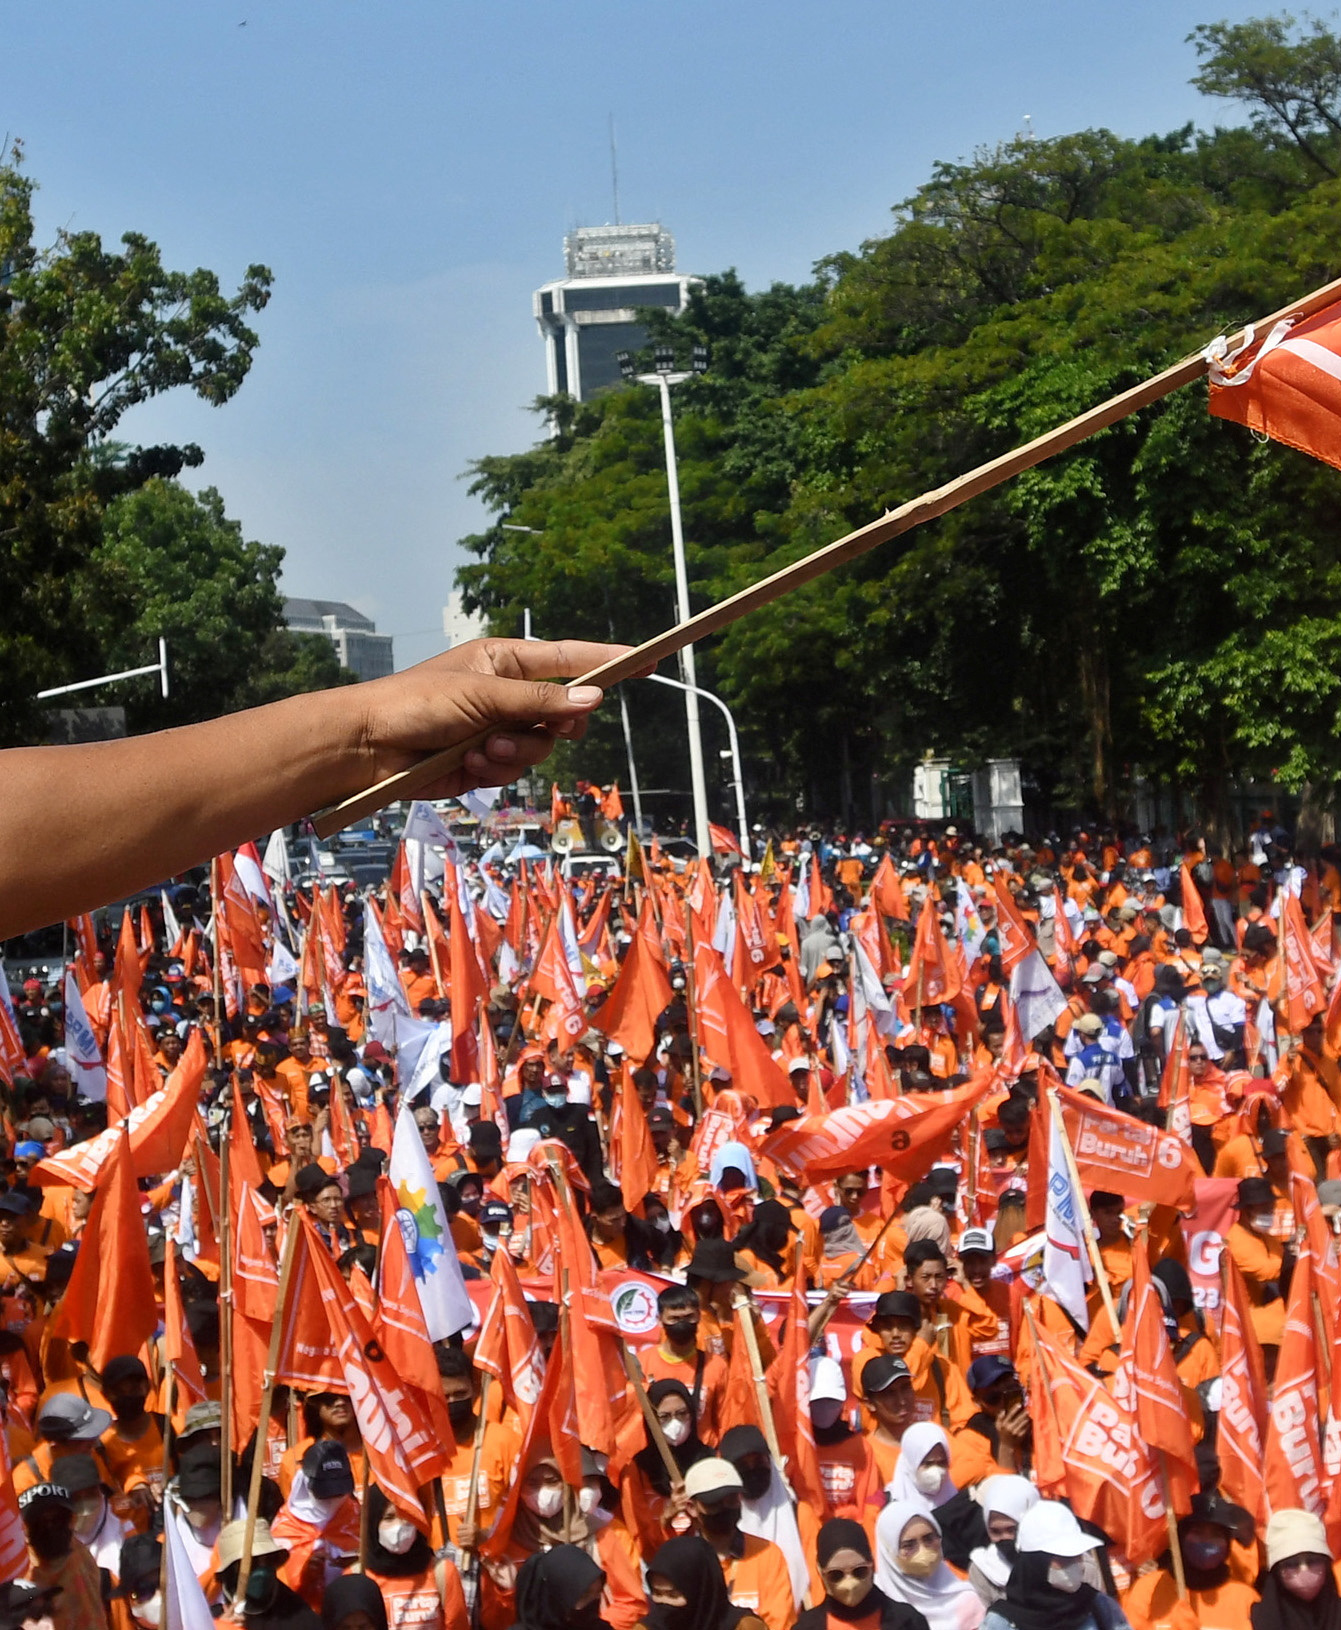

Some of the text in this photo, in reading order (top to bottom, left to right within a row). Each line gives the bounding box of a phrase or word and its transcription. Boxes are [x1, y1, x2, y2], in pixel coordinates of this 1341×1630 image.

[1079, 1132, 1150, 1167] Buruh
[1158, 1137, 1183, 1169] 6
[18, 1483, 70, 1509] SPORT
